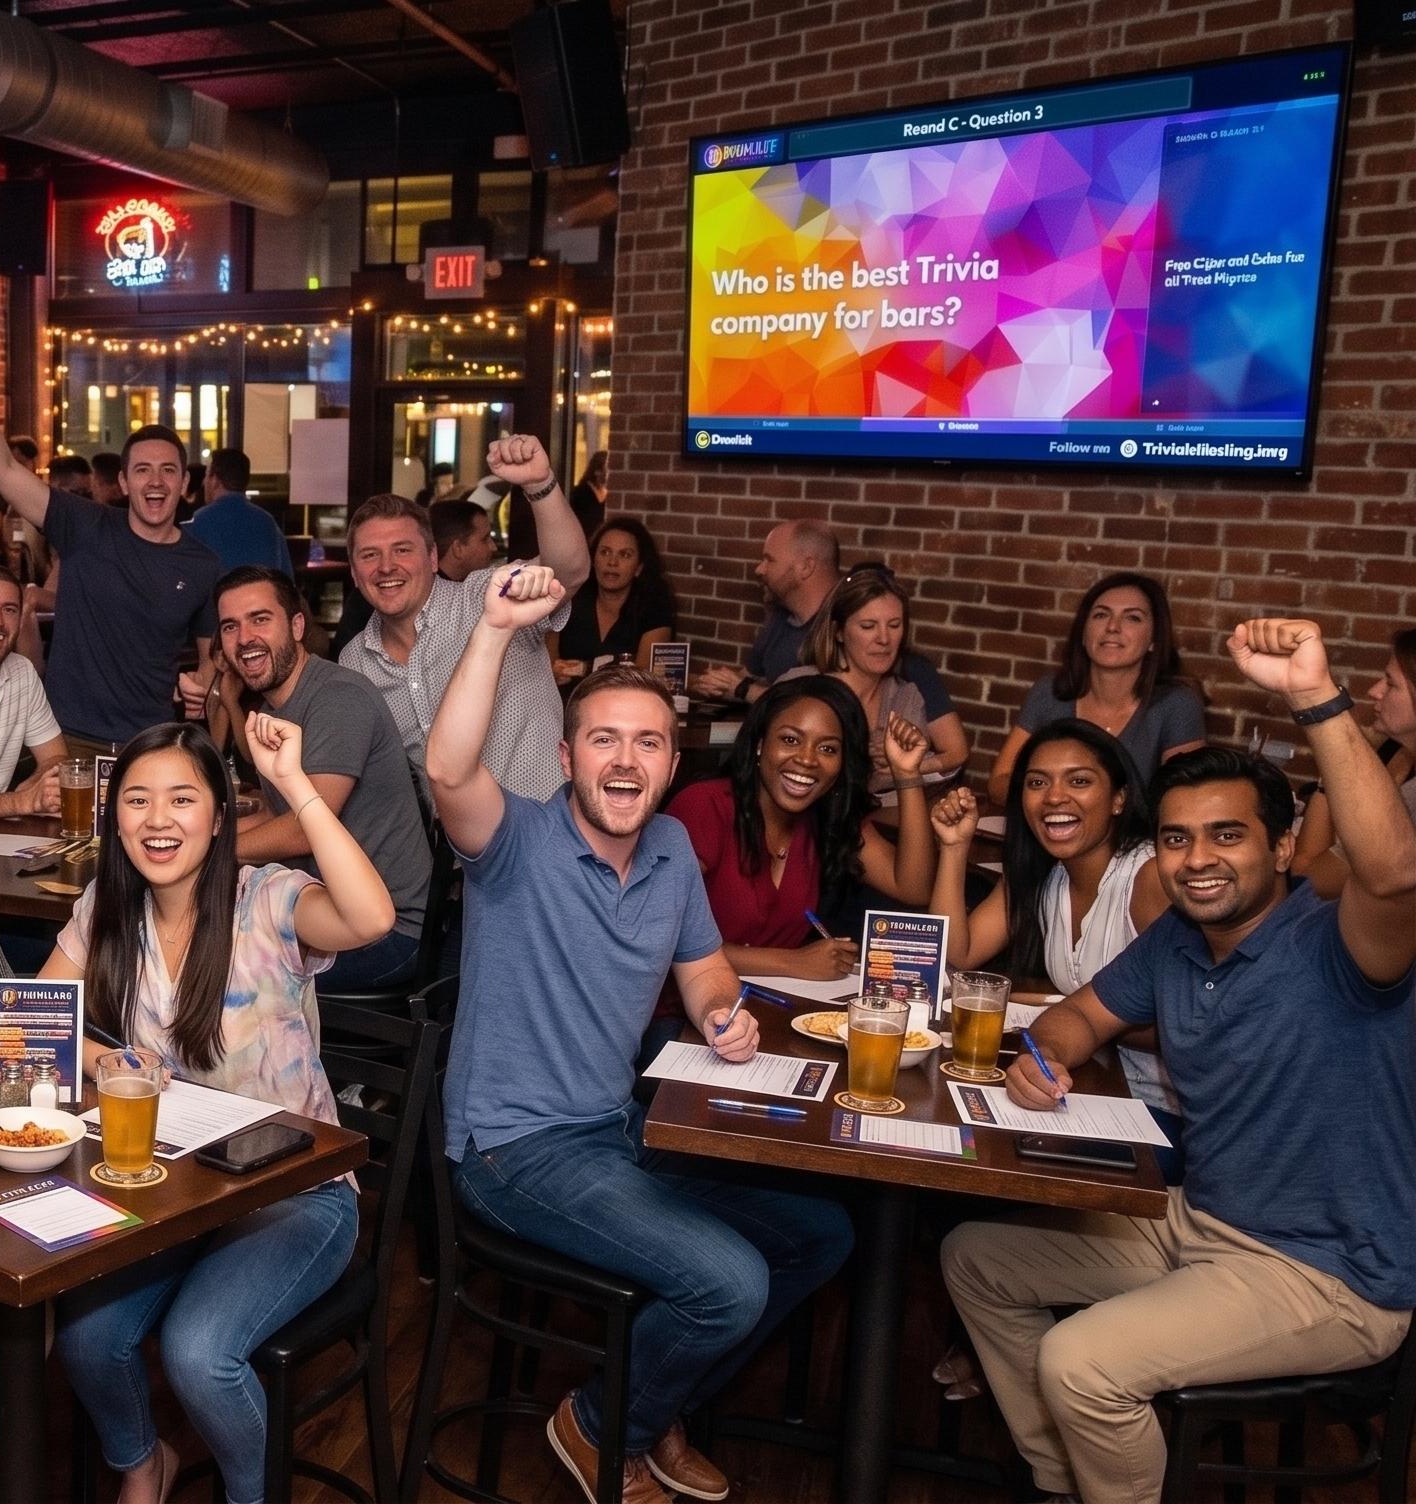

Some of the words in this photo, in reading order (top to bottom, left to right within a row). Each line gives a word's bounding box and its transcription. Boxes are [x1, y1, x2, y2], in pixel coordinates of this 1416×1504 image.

[948, 117, 959, 131] C
[969, 109, 1031, 130] Question
[1034, 105, 1044, 120] 3
[435, 255, 476, 288] EXIT
[711, 269, 769, 295] Who
[776, 266, 795, 293] is
[801, 263, 844, 291] the
[851, 260, 910, 288] best
[916, 251, 999, 284] Trivia
[710, 310, 828, 340] company
[833, 302, 874, 330] for
[880, 296, 962, 328] bars?
